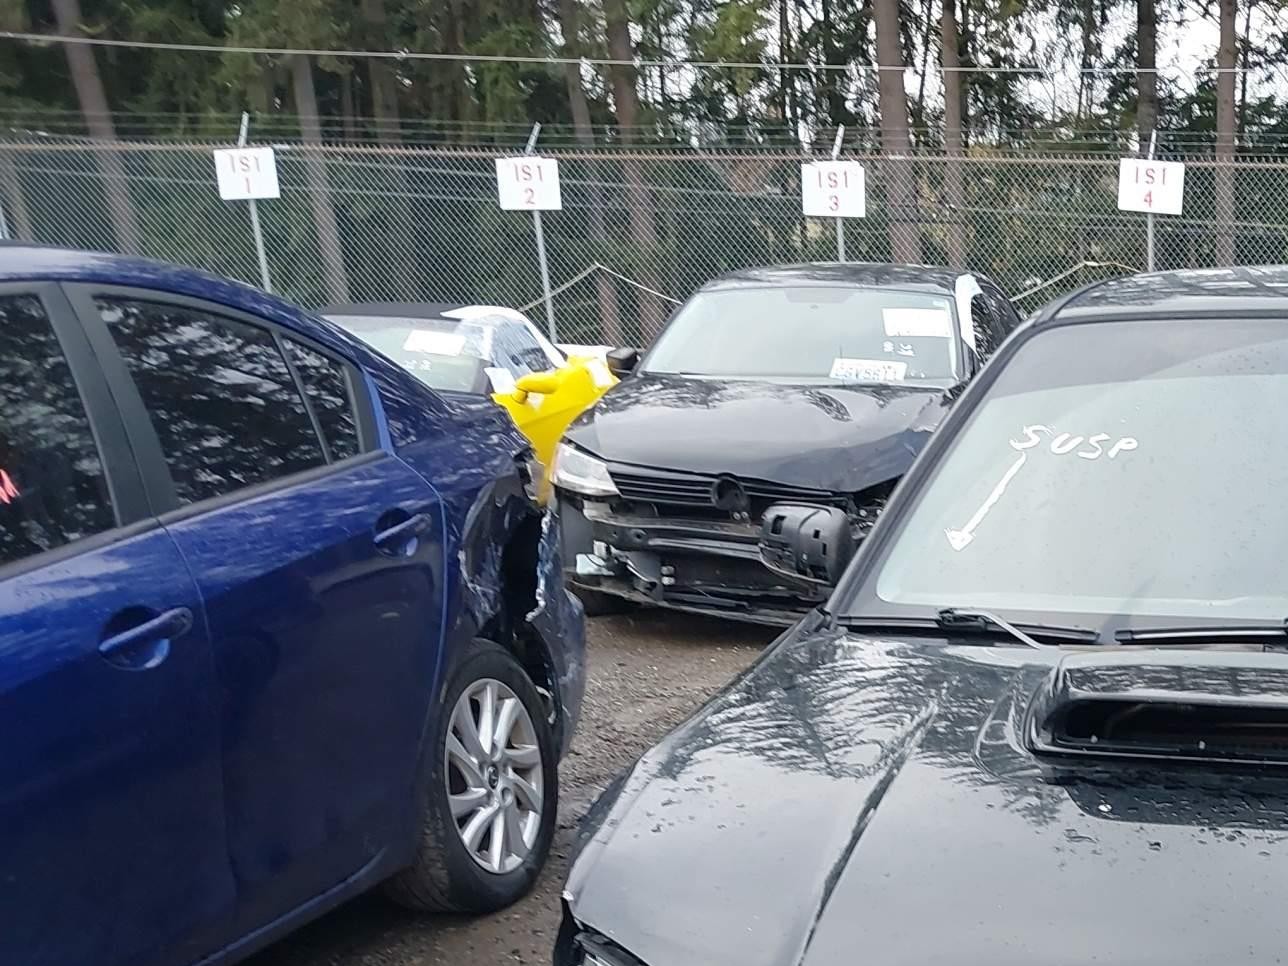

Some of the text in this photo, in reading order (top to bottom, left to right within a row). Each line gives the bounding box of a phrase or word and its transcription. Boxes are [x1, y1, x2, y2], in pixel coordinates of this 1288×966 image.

[524, 187, 535, 205] 2
[829, 195, 839, 211] 3
[1144, 190, 1153, 208] 4
[1009, 425, 1139, 459] SUSP
